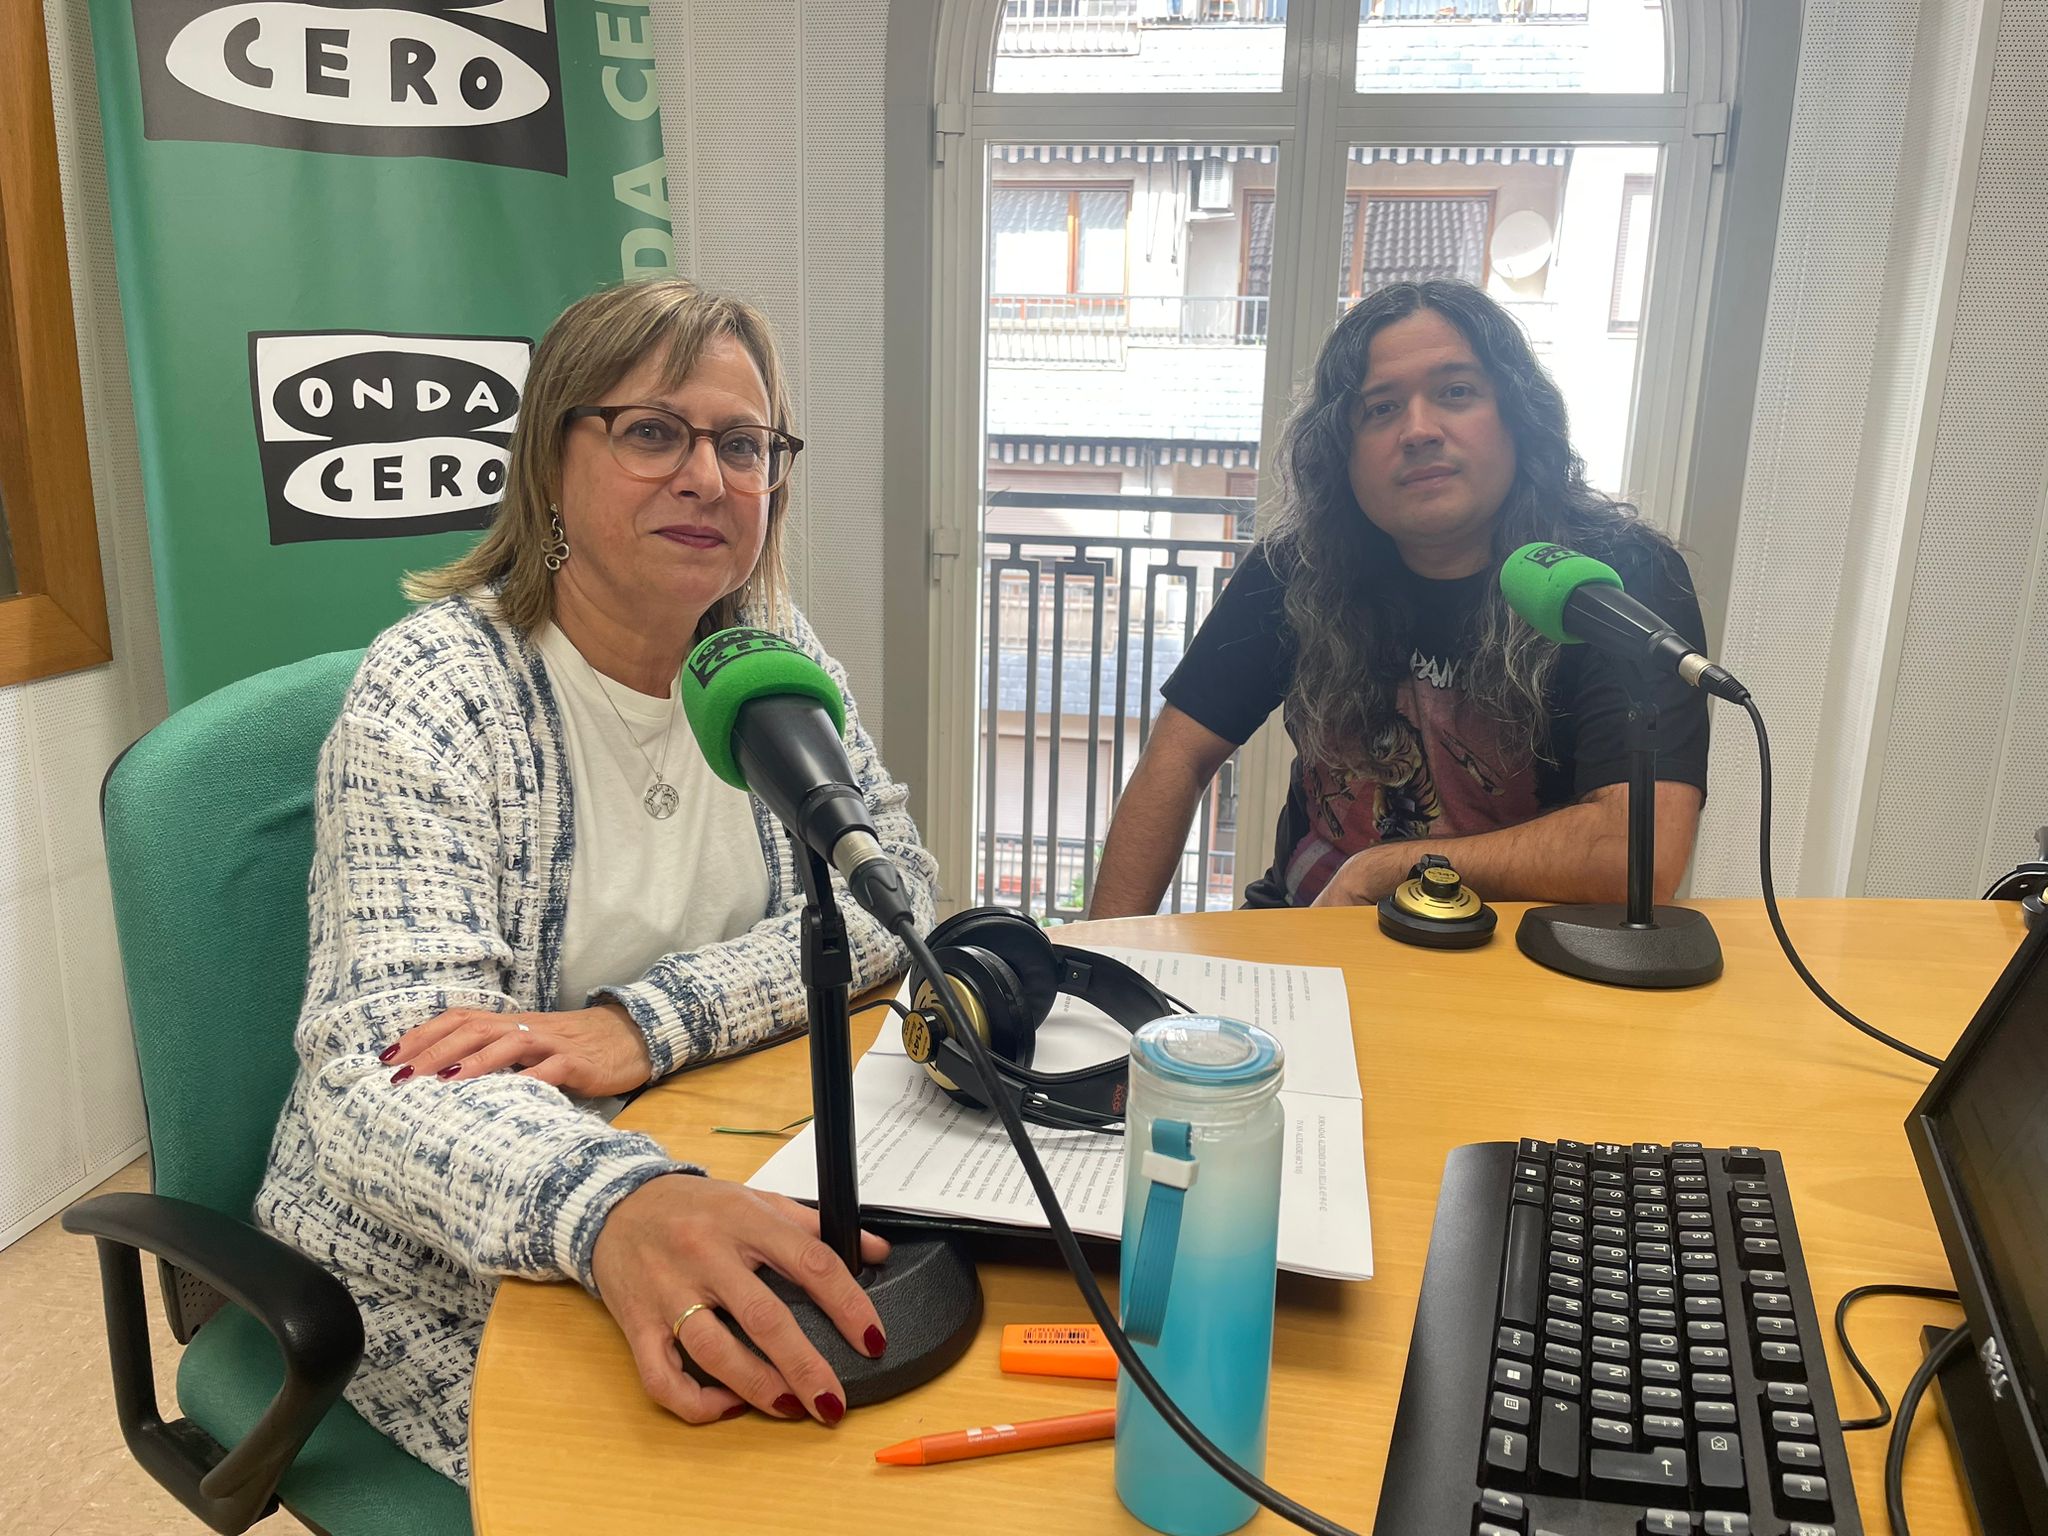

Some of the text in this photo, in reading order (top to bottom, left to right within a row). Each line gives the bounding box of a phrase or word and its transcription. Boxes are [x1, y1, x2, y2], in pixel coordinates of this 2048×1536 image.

[223, 17, 502, 110] CERO
[593, 0, 660, 121] CE
[299, 377, 500, 418] ONDA
[320, 455, 505, 501] CERO
[1650, 1188, 1661, 1196] W
[1568, 1216, 1580, 1224] C
[1611, 1228, 1623, 1236] F
[1611, 1249, 1623, 1257] G
[1567, 1256, 1579, 1264] B
[1611, 1271, 1623, 1279] H
[1566, 1277, 1579, 1287] N
[1611, 1293, 1624, 1301] J
[1656, 1289, 1669, 1297] U
[1565, 1300, 1578, 1311] M
[1612, 1316, 1625, 1326] K
[1772, 1321, 1782, 1329] F7
[1660, 1337, 1674, 1346] O
[1609, 1367, 1626, 1377] Ñ
[1661, 1364, 1675, 1373] P
